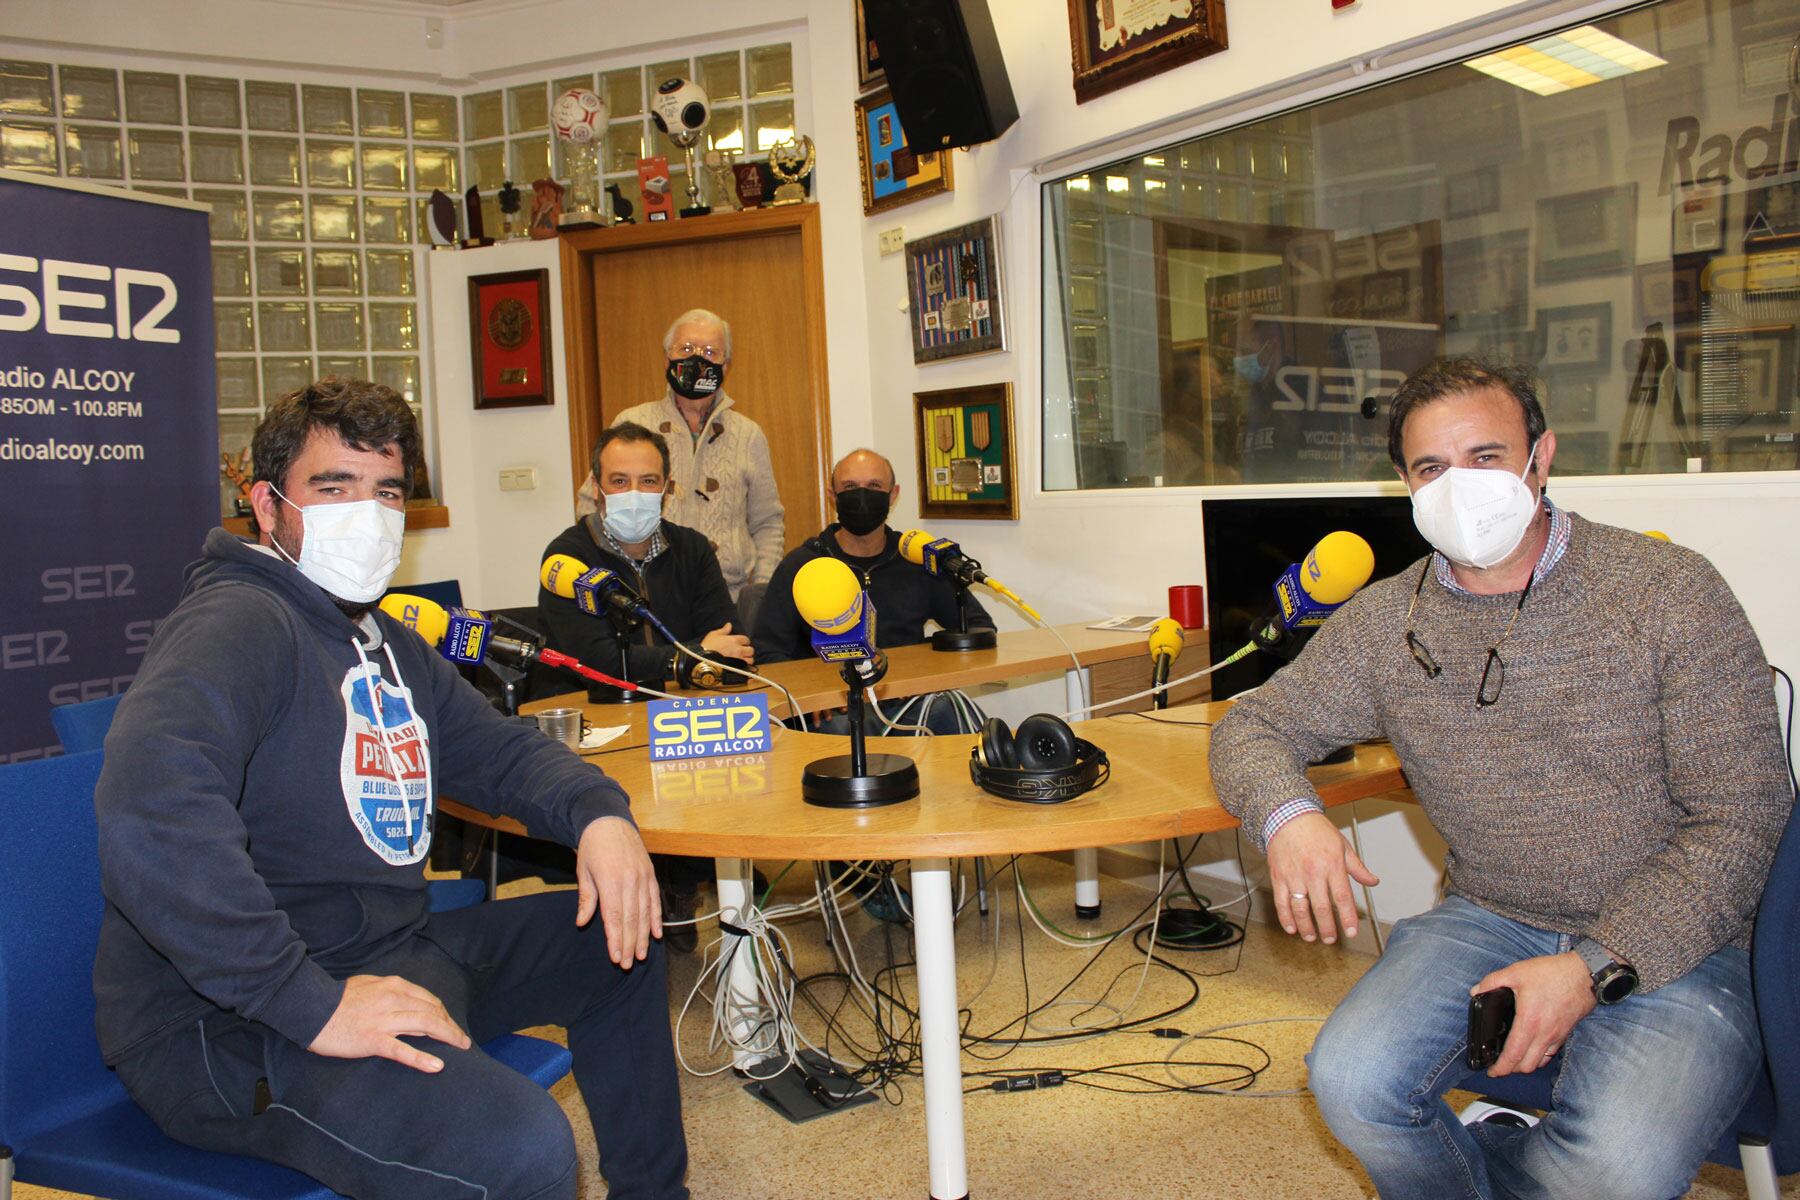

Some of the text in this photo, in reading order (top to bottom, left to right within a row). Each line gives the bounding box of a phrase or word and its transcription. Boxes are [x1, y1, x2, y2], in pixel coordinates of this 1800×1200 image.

[51, 368, 136, 392] ALCOY
[72, 400, 143, 418] 100.8FM
[0, 438, 145, 465] dioalcoy.com
[41, 563, 137, 603] SER
[402, 604, 420, 632] ER
[813, 592, 861, 628] SER
[0, 630, 70, 669] ER
[449, 622, 462, 656] RADIO ALCOY
[460, 623, 472, 657] CADENA
[466, 624, 483, 659] SER
[672, 696, 741, 708] CADENA
[653, 705, 764, 746] SER
[655, 739, 764, 758] RADIO ALCOY
[362, 780, 386, 794] BLUE
